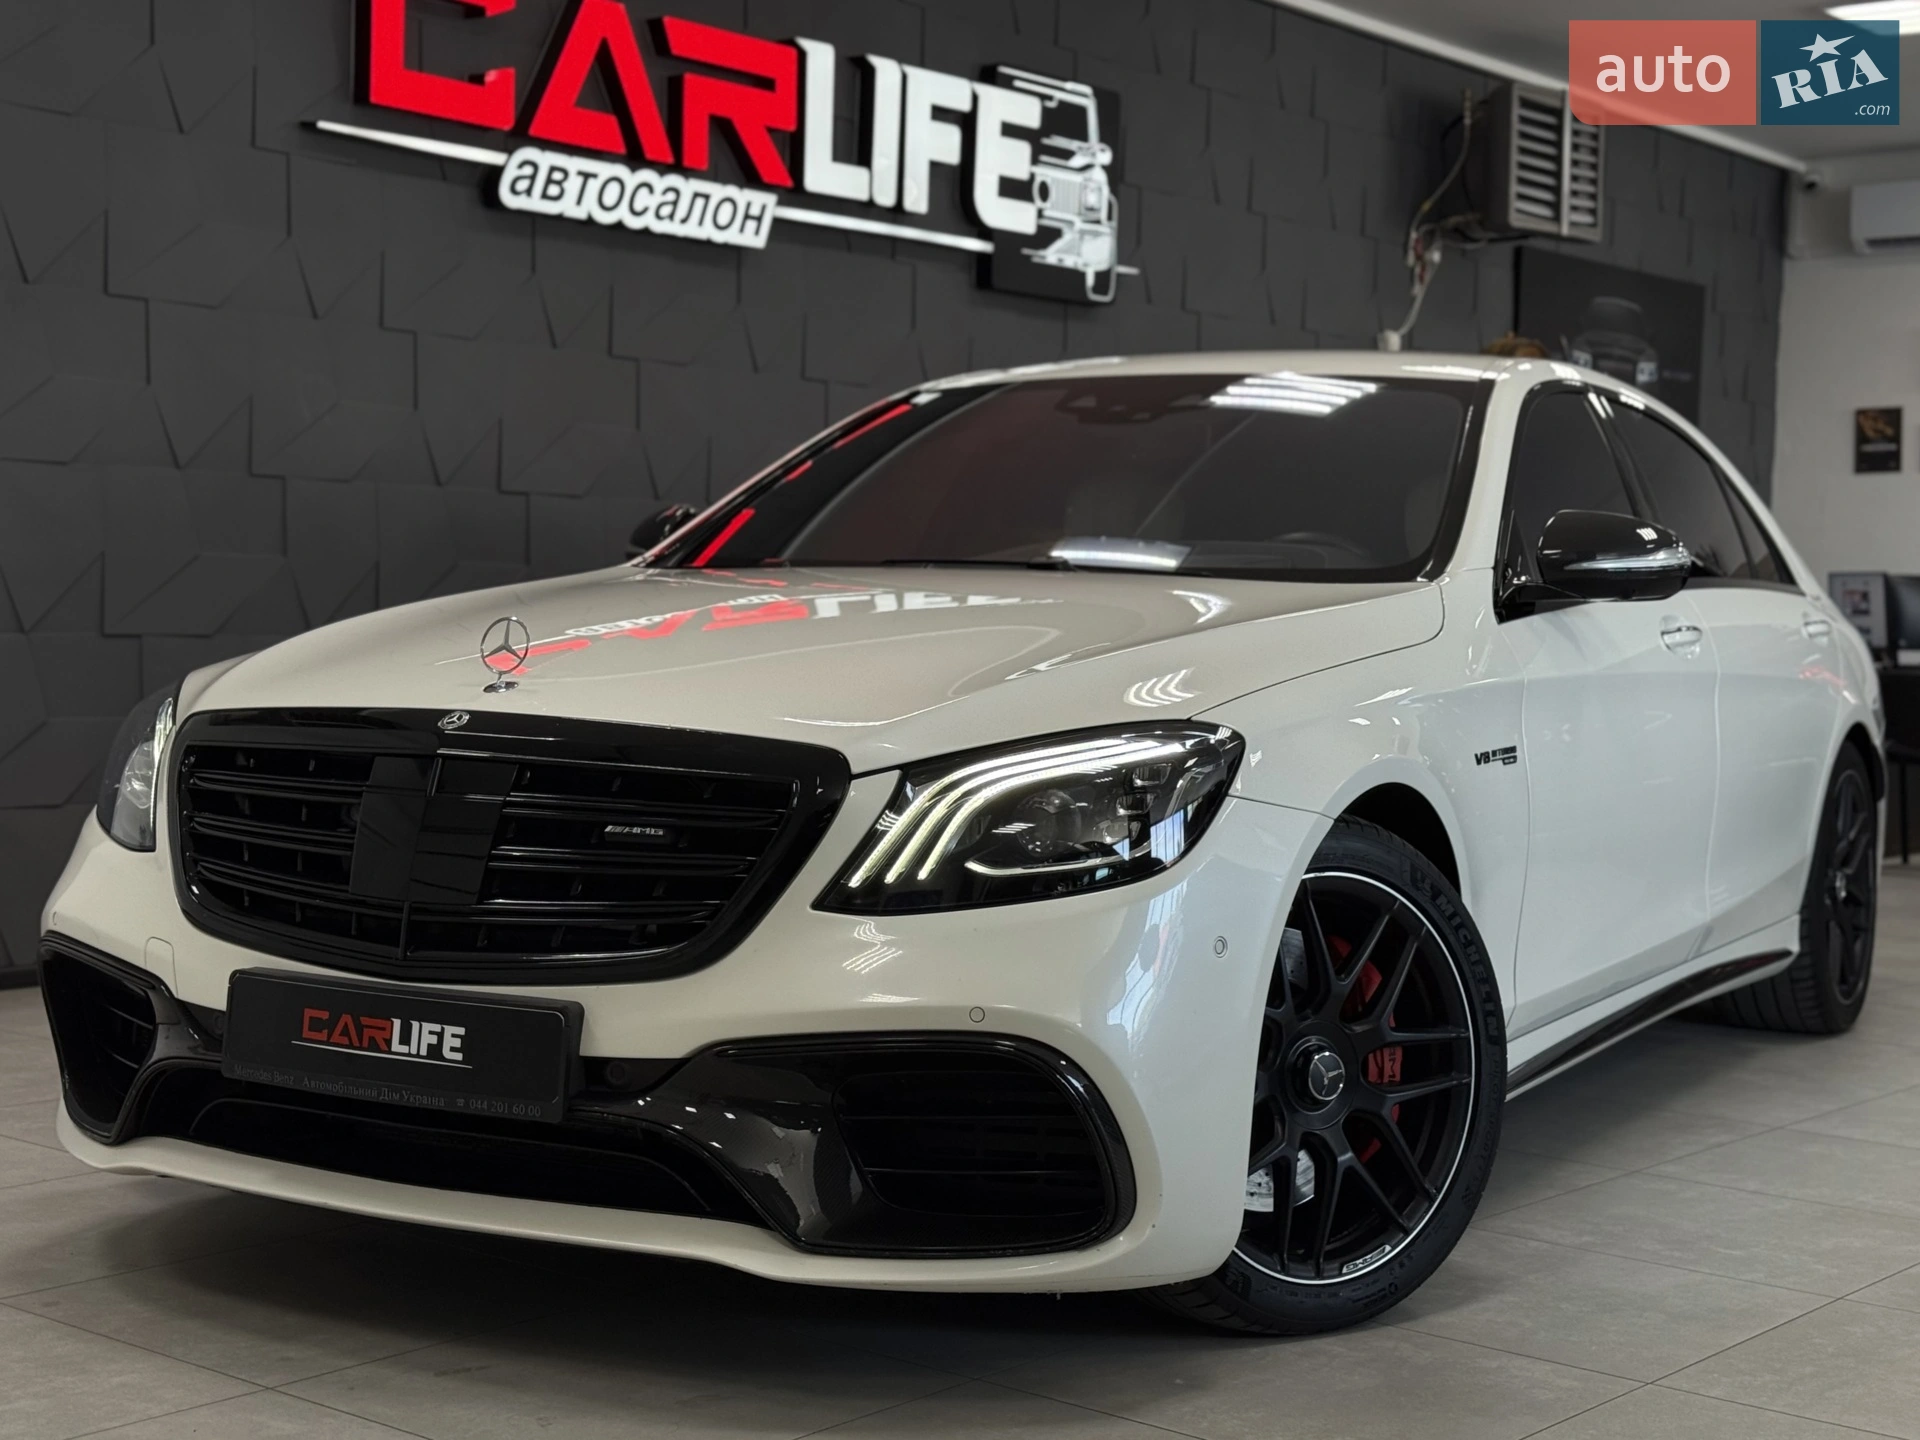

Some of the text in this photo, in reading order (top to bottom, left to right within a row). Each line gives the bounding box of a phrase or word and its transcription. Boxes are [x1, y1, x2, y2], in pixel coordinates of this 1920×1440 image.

[370, 0, 1042, 235] CARLIFE
[508, 156, 773, 238] автосалон
[1474, 751, 1491, 766] V8
[1435, 893, 1499, 1037] MICHELIN
[302, 1008, 466, 1061] CARLIFE
[302, 1076, 378, 1098] Автомобільний
[379, 1087, 400, 1102] Дім
[469, 1099, 488, 1110] 044
[490, 1101, 508, 1113] 201
[512, 1103, 525, 1115] 60
[528, 1105, 541, 1117] 00
